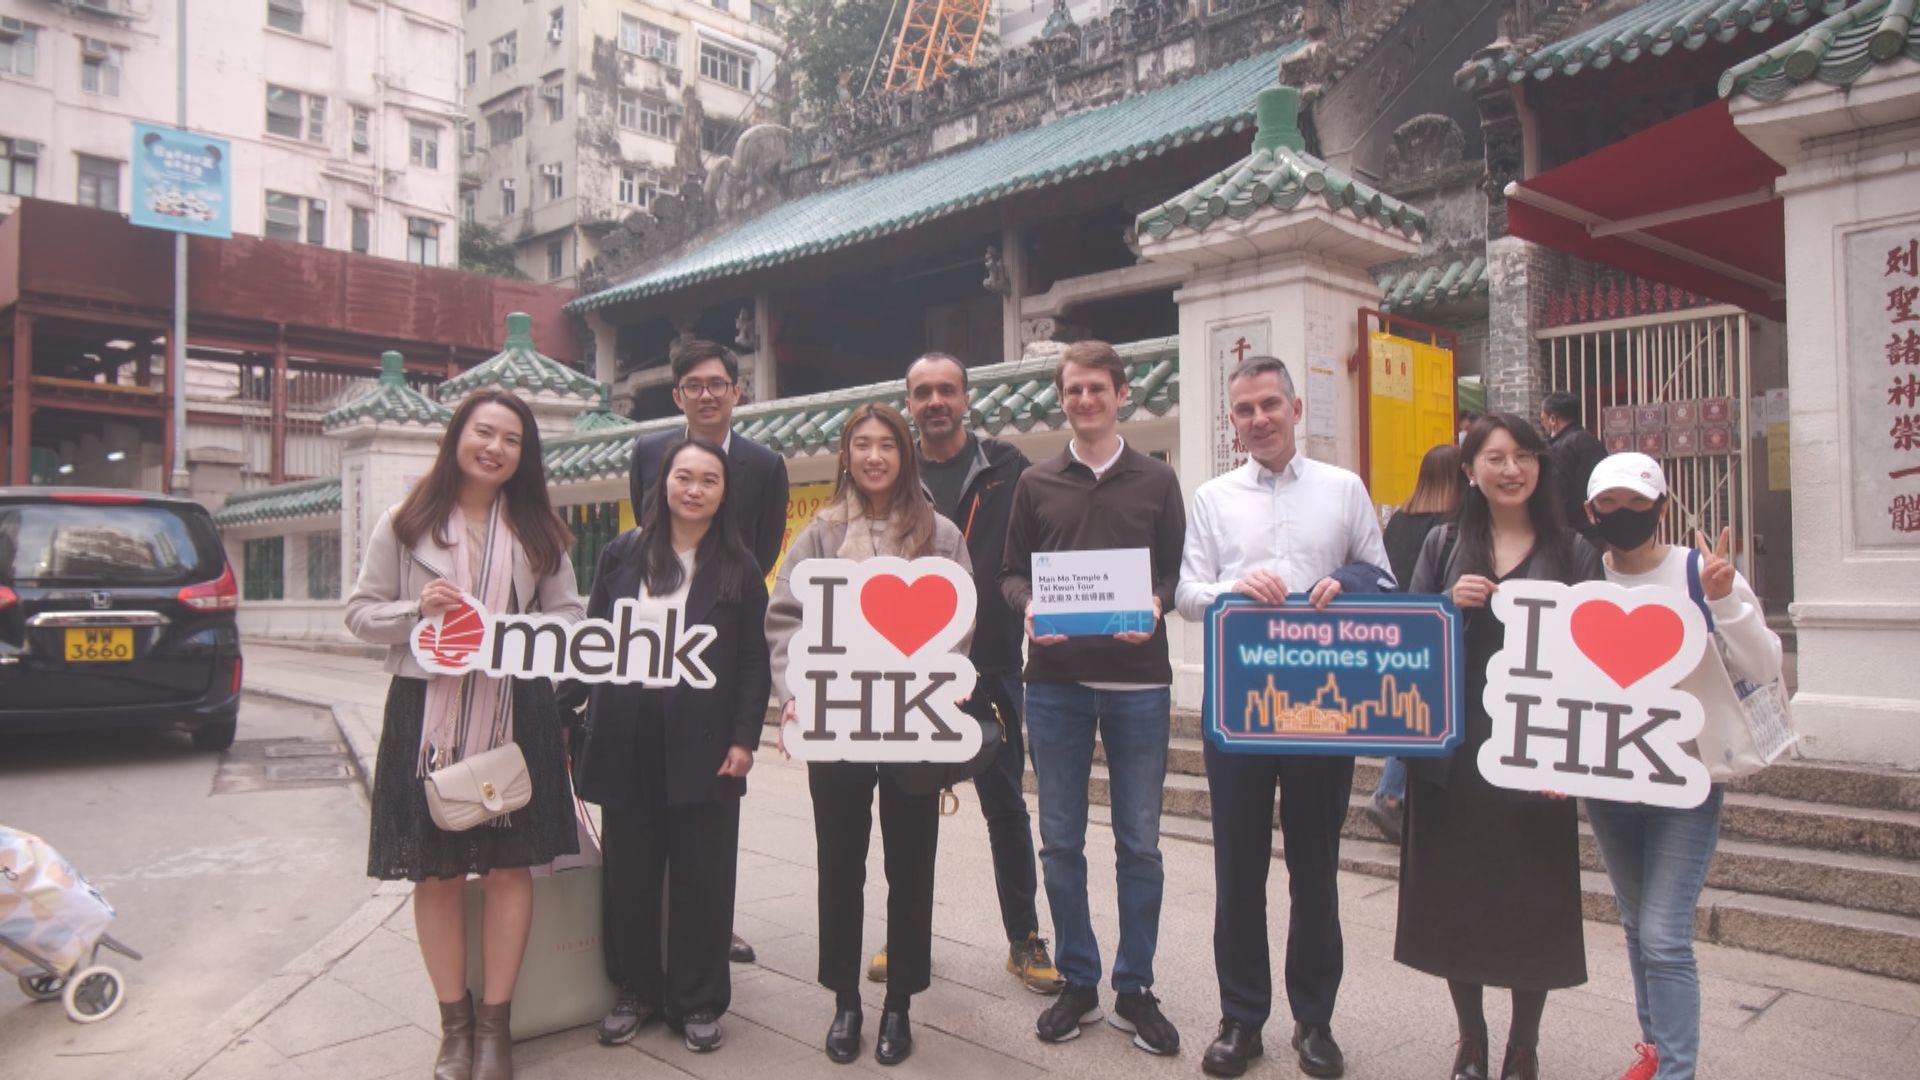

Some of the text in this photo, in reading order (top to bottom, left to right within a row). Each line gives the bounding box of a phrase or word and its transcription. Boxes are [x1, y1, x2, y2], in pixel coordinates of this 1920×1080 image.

[1039, 575, 1055, 583] Man
[1072, 574, 1101, 583] Temple
[1077, 582, 1094, 590] Tour
[809, 577, 848, 654] I
[85, 628, 113, 643] WW
[491, 605, 708, 682] mehk
[1268, 619, 1401, 646] Hong Kong
[1509, 598, 1557, 679] I
[71, 644, 128, 659] 3660
[1239, 644, 1430, 673] Welcomes you!
[803, 670, 963, 741] HK
[1500, 693, 1687, 786] HK
